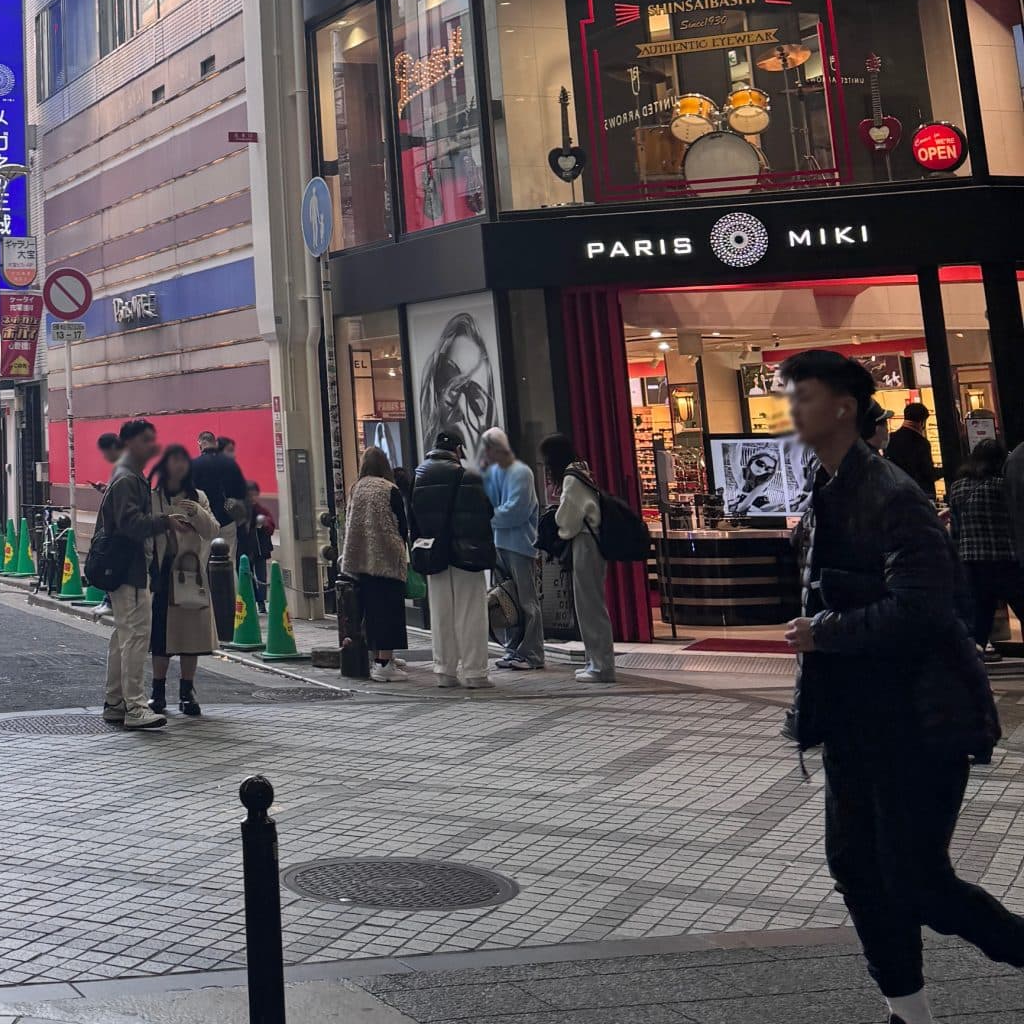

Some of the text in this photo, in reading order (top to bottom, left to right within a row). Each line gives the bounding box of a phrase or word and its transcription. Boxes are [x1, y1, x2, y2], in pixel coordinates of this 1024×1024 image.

[640, 32, 774, 56] AUTHENTIC EYEWEAR
[917, 144, 958, 162] OPEN
[587, 224, 869, 259] PARIS MIKI
